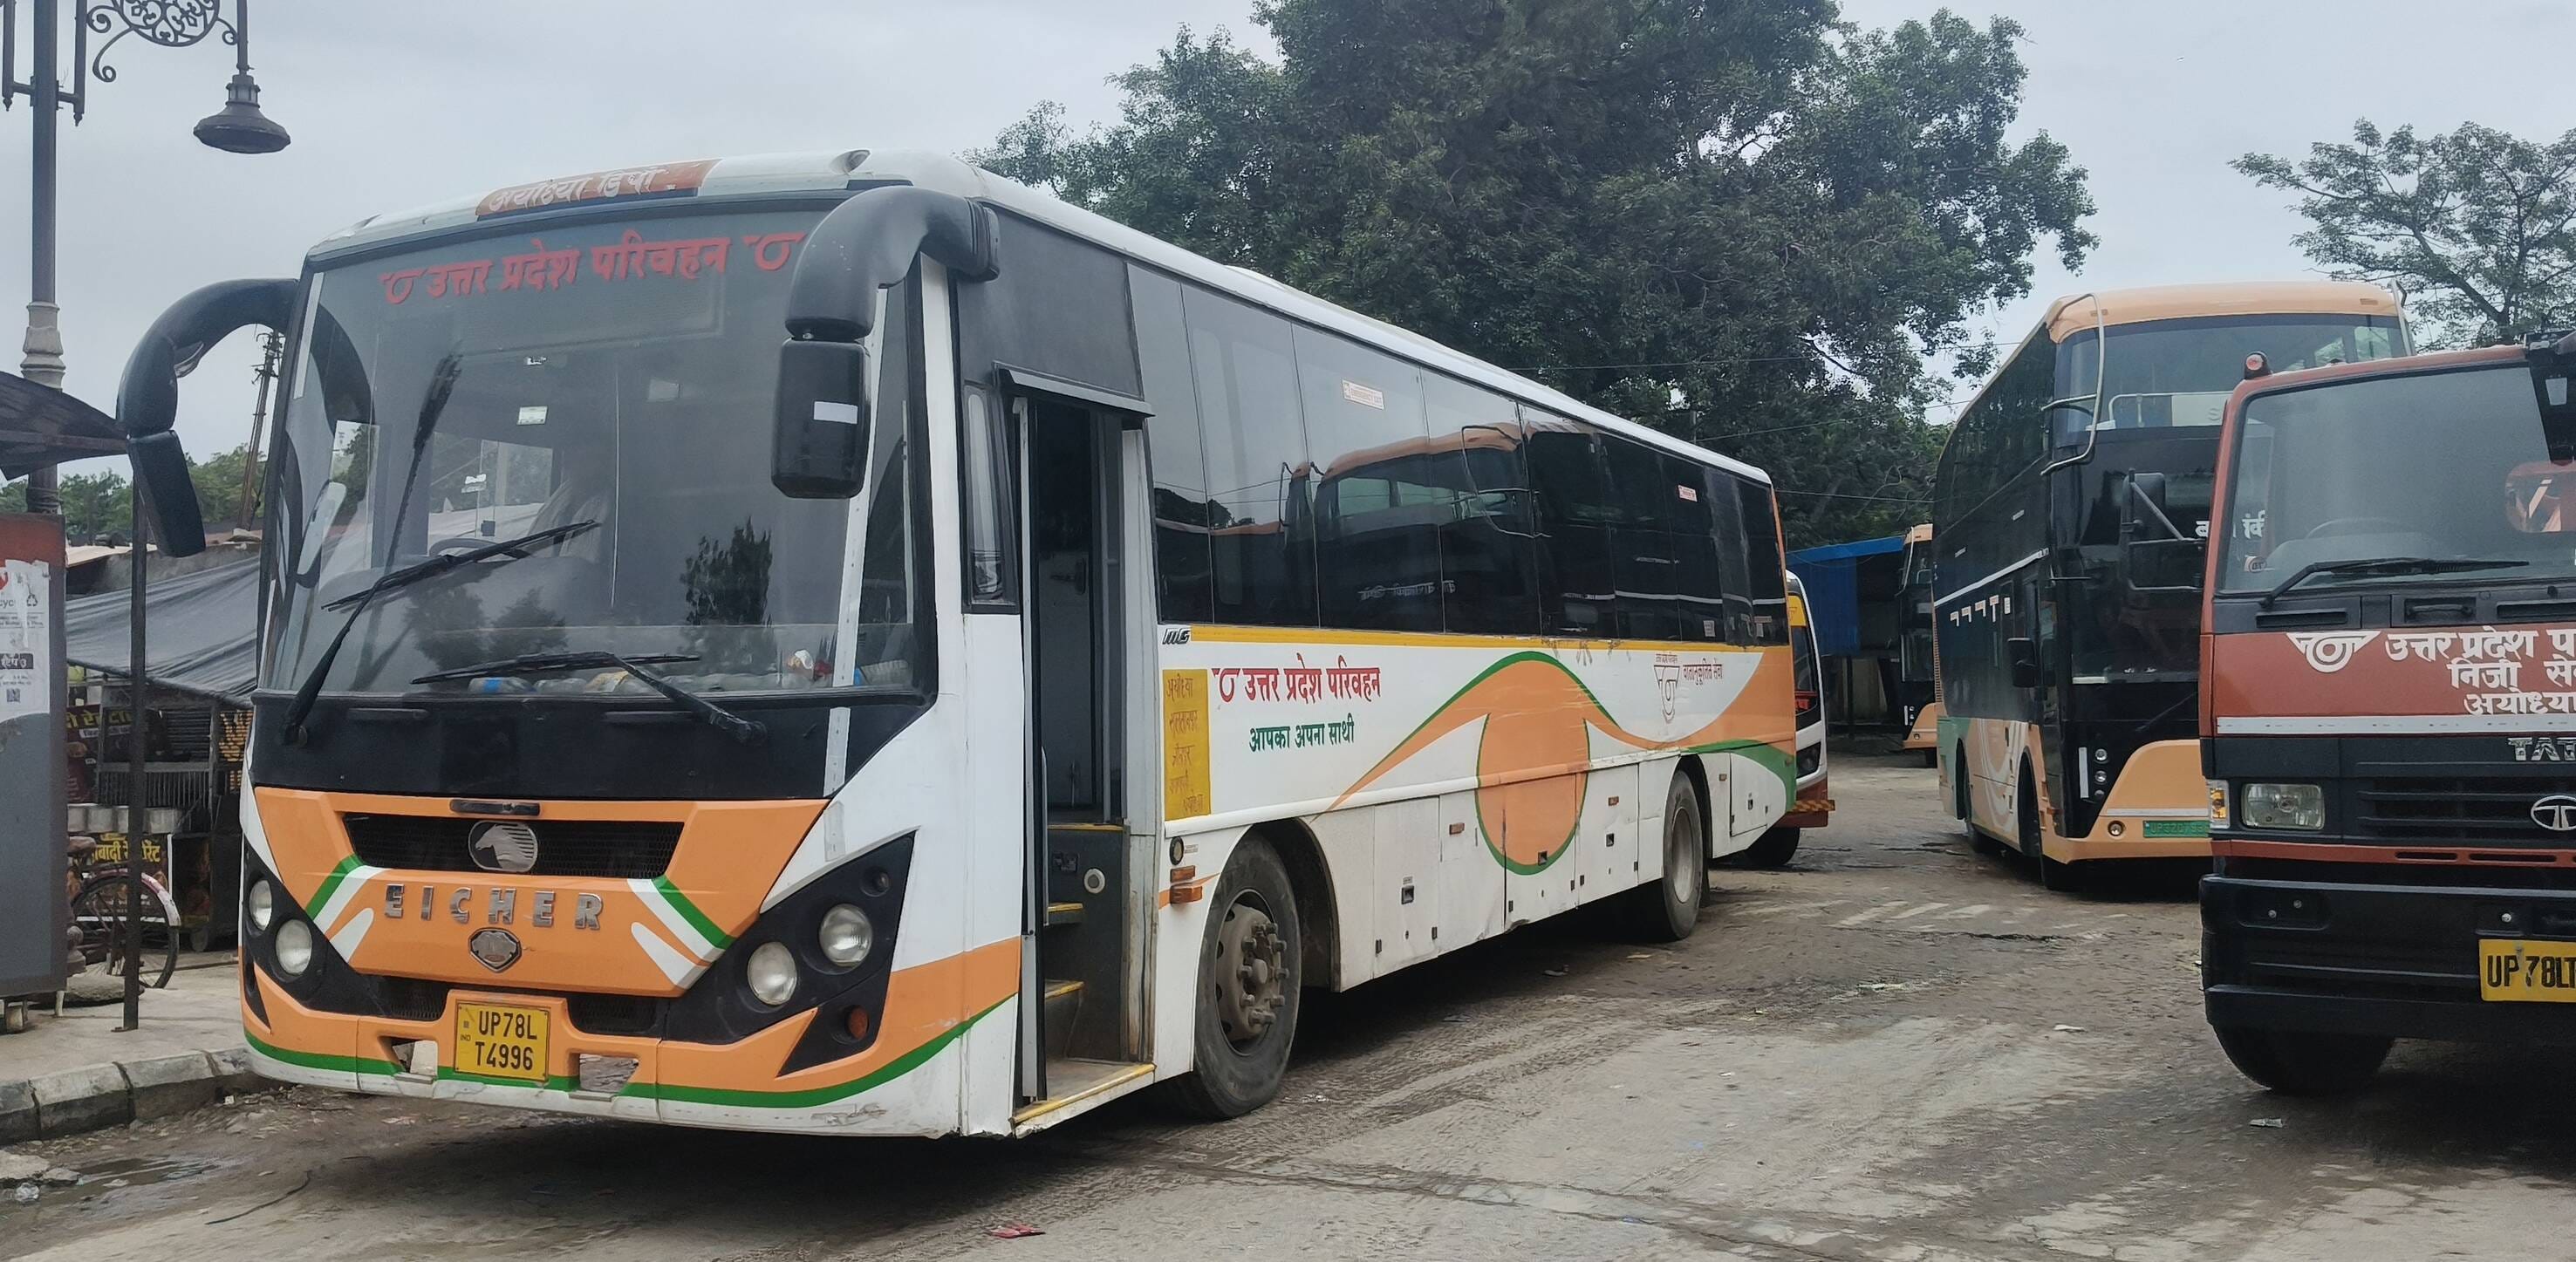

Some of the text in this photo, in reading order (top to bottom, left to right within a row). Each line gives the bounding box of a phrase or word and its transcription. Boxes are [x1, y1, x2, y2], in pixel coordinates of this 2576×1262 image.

[426, 229, 731, 298] उत्तर प्रदेश परिवहन
[2385, 632, 2457, 661] उत्तर
[2458, 625, 2538, 660] प्रदेश
[1242, 652, 1381, 705] उत्तर प्रदेश परिवहन
[2446, 653, 2576, 689] निजी से
[1249, 713, 1355, 752] आपका अपना साथी
[384, 883, 604, 930] EICHER
[479, 1011, 537, 1040] UP78L
[475, 1041, 534, 1070] T4996
